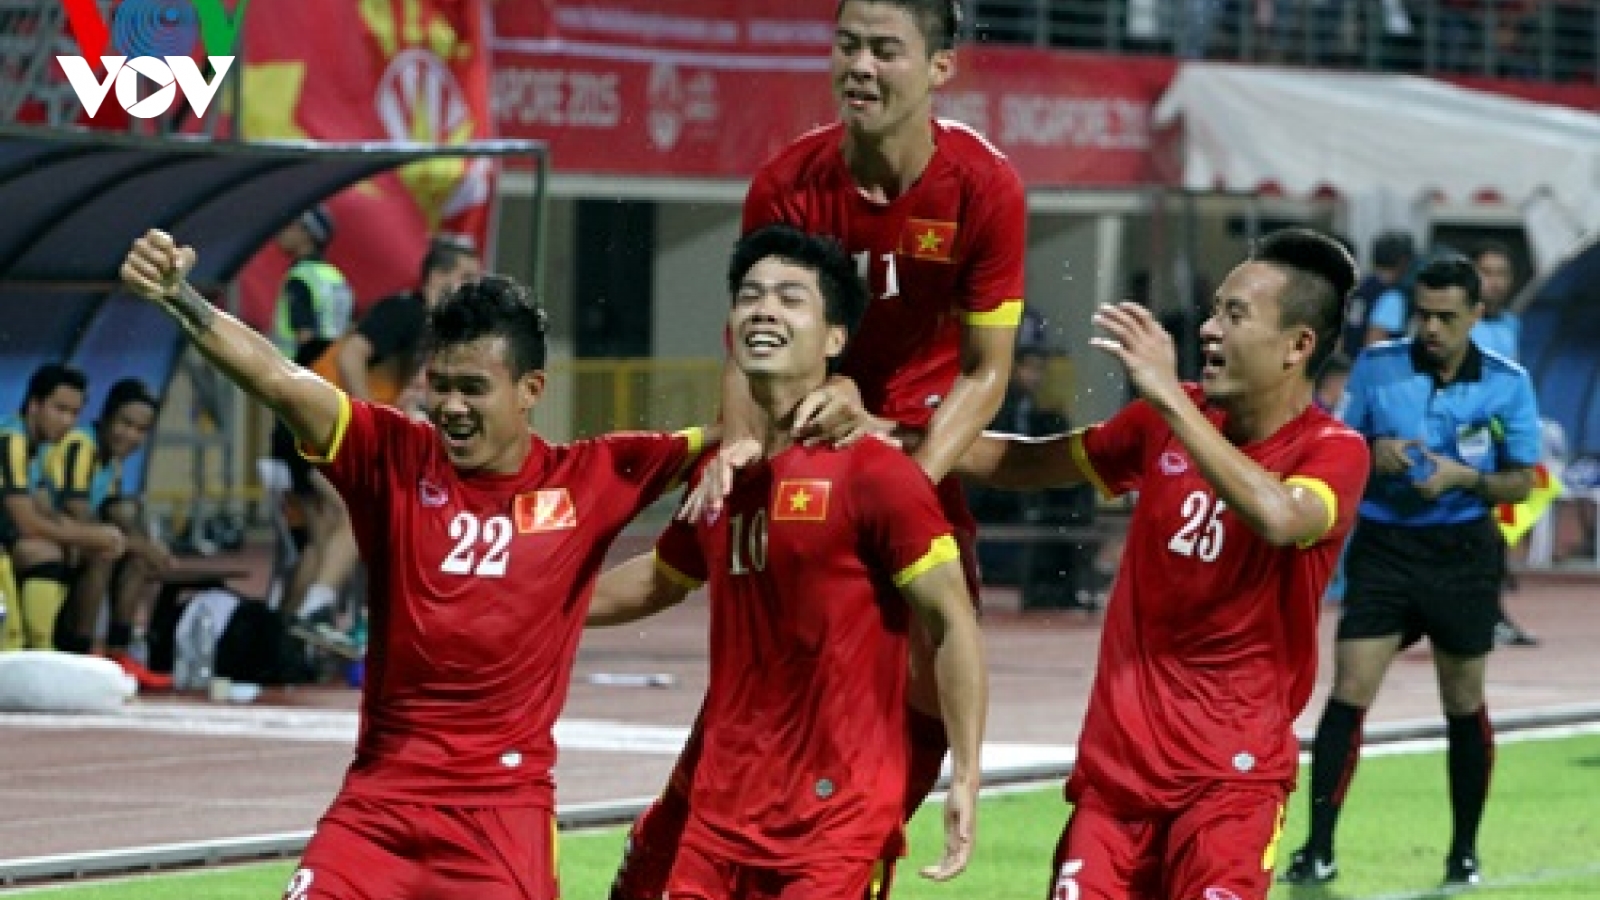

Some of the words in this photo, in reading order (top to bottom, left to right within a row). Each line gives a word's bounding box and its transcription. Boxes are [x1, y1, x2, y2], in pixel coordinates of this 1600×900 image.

[566, 72, 621, 128] 2015
[440, 510, 513, 577] 22
[729, 507, 768, 575] 10
[1168, 490, 1226, 562] 25
